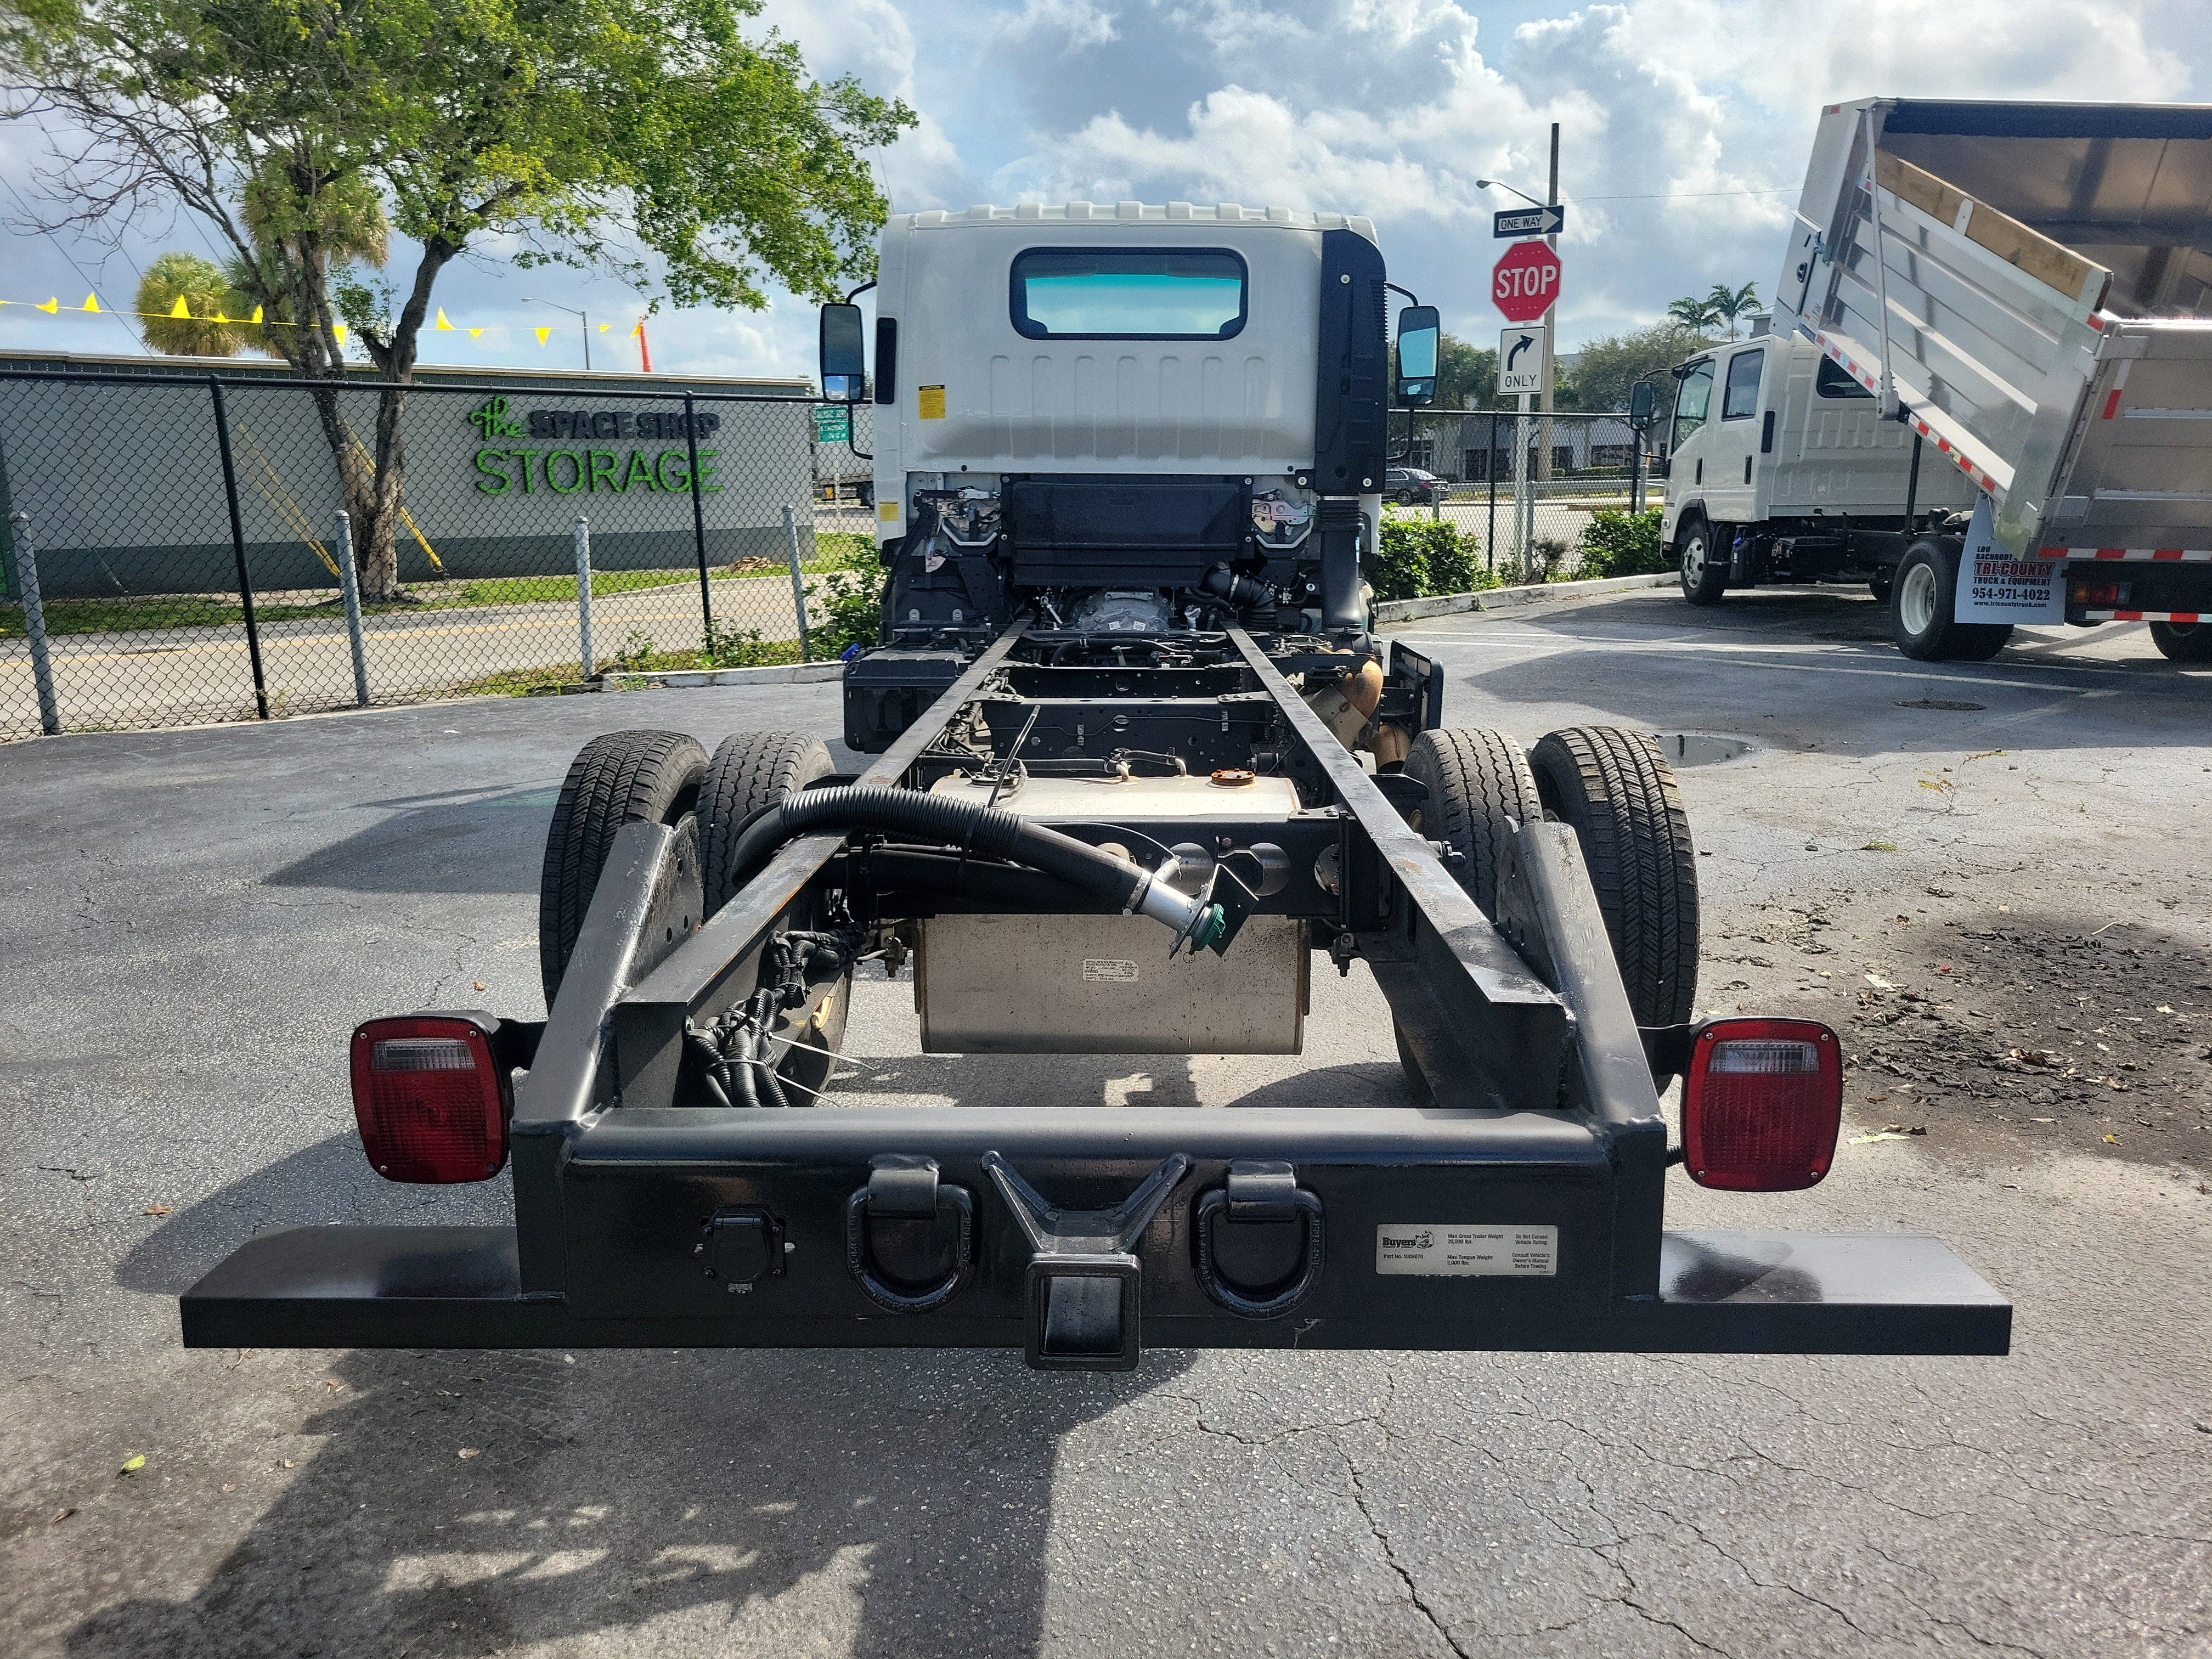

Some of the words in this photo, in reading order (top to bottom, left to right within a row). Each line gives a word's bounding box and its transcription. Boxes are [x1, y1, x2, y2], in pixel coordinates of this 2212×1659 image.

[1501, 218, 1520, 229] ONE
[1522, 216, 1542, 227] WAY
[1496, 266, 1556, 298] STOP
[1505, 374, 1537, 388] ONLY
[468, 395, 531, 441] the
[529, 410, 636, 439] SPACE
[636, 411, 721, 439] SHOP
[474, 448, 725, 494] STORAGE
[1974, 561, 2054, 577] TRI-COUNTY
[2008, 578, 2051, 586] EQUIPMENT
[1972, 587, 2051, 601] 954-971-4022
[1383, 1237, 1416, 1248] Buyers
